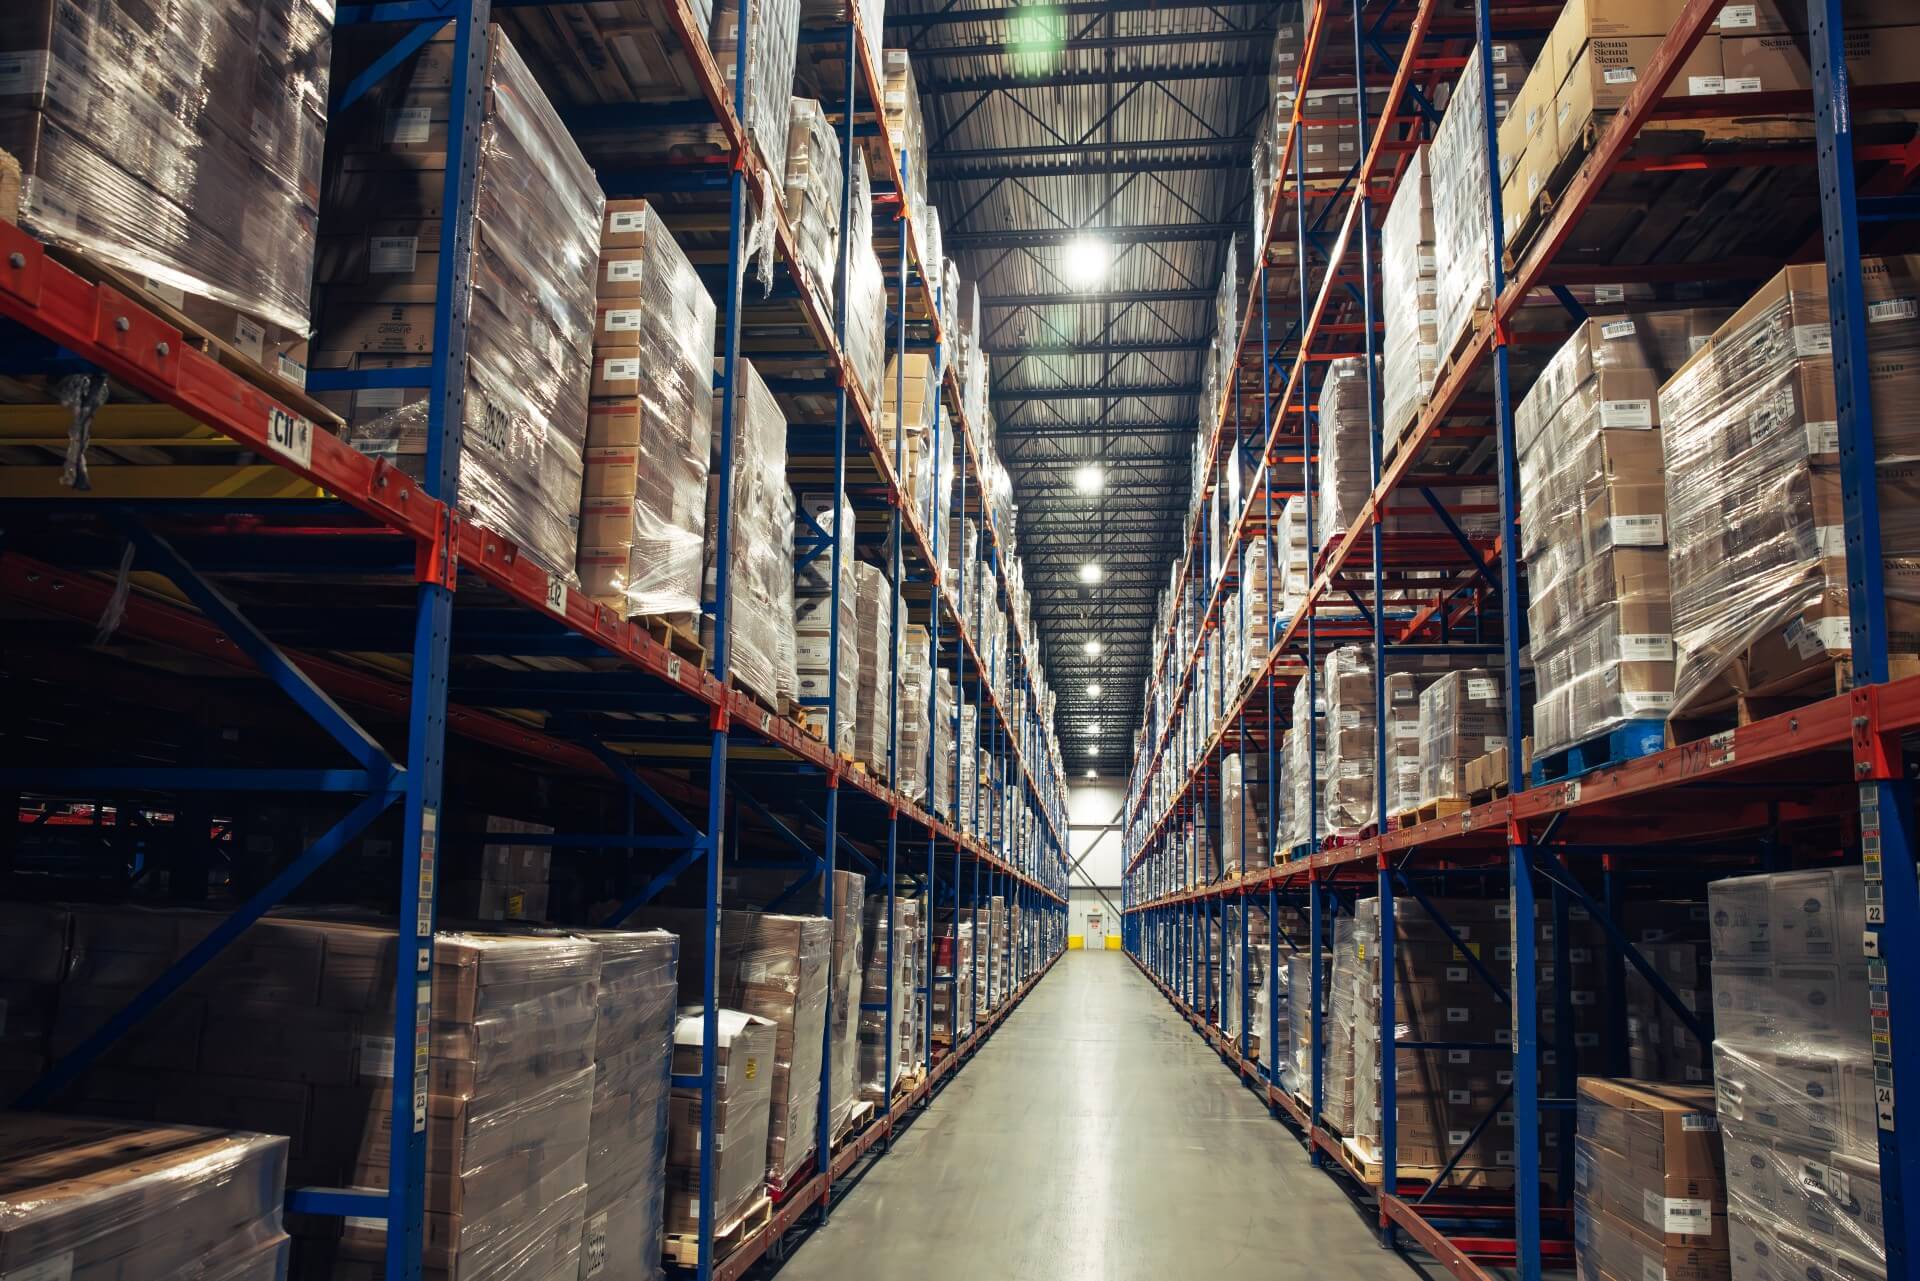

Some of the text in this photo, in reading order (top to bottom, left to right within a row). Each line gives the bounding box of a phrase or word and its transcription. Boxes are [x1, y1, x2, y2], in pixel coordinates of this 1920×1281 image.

[1593, 40, 1628, 49] Sienna
[1594, 48, 1628, 56] Sienna
[1594, 56, 1629, 64] Sienna
[1869, 907, 1881, 921] 22
[419, 922, 428, 934] 21
[1878, 1088, 1890, 1103] 24
[416, 1096, 425, 1108] 23
